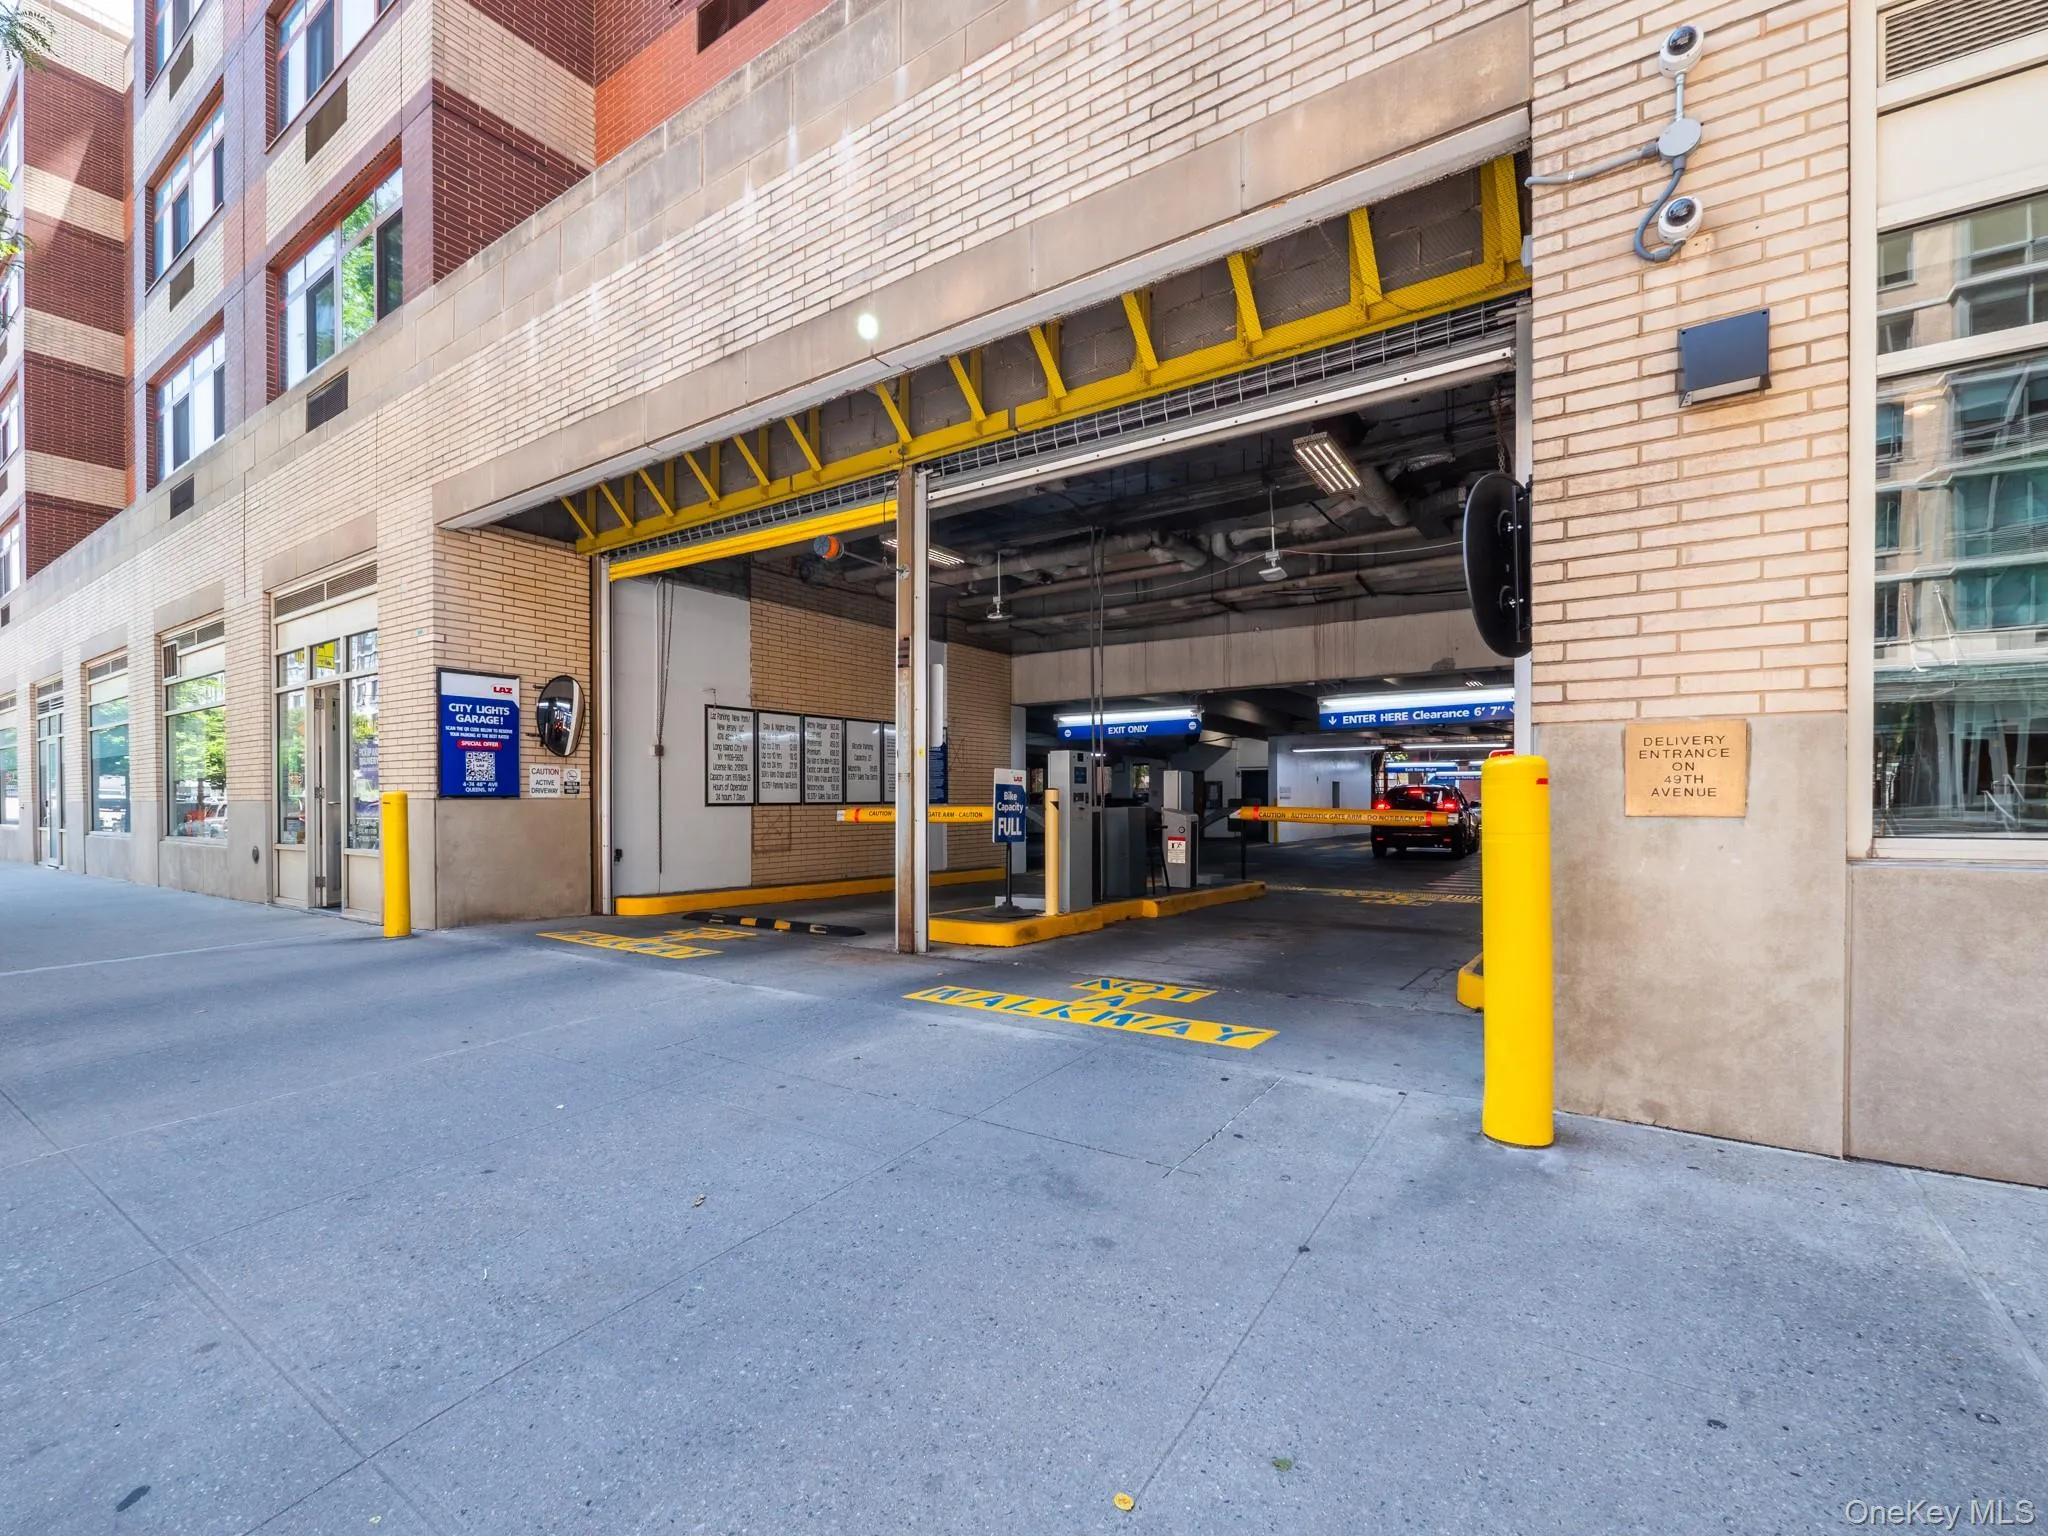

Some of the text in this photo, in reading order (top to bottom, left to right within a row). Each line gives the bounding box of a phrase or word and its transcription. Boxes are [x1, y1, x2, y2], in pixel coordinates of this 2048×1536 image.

[449, 703, 510, 715] CITY LIGHTS
[1342, 715, 1376, 725] ENTER
[1380, 712, 1409, 722] HERE
[1413, 708, 1470, 720] Clearance
[1108, 725, 1148, 734] EXIT ONLY
[1643, 736, 1726, 746] DELIVERY
[713, 742, 722, 752] Long
[1639, 748, 1730, 759] ENTRANCE
[1672, 762, 1695, 771] ON
[1664, 774, 1704, 784] 49TH
[1004, 792, 1017, 800] Bike
[1650, 787, 1717, 797] AVENUE
[997, 802, 1023, 813] Capacity
[998, 817, 1022, 836] FULL
[1081, 978, 1201, 998] NOT
[1084, 995, 1126, 1006] A
[923, 987, 1264, 1042] WALKWAY
